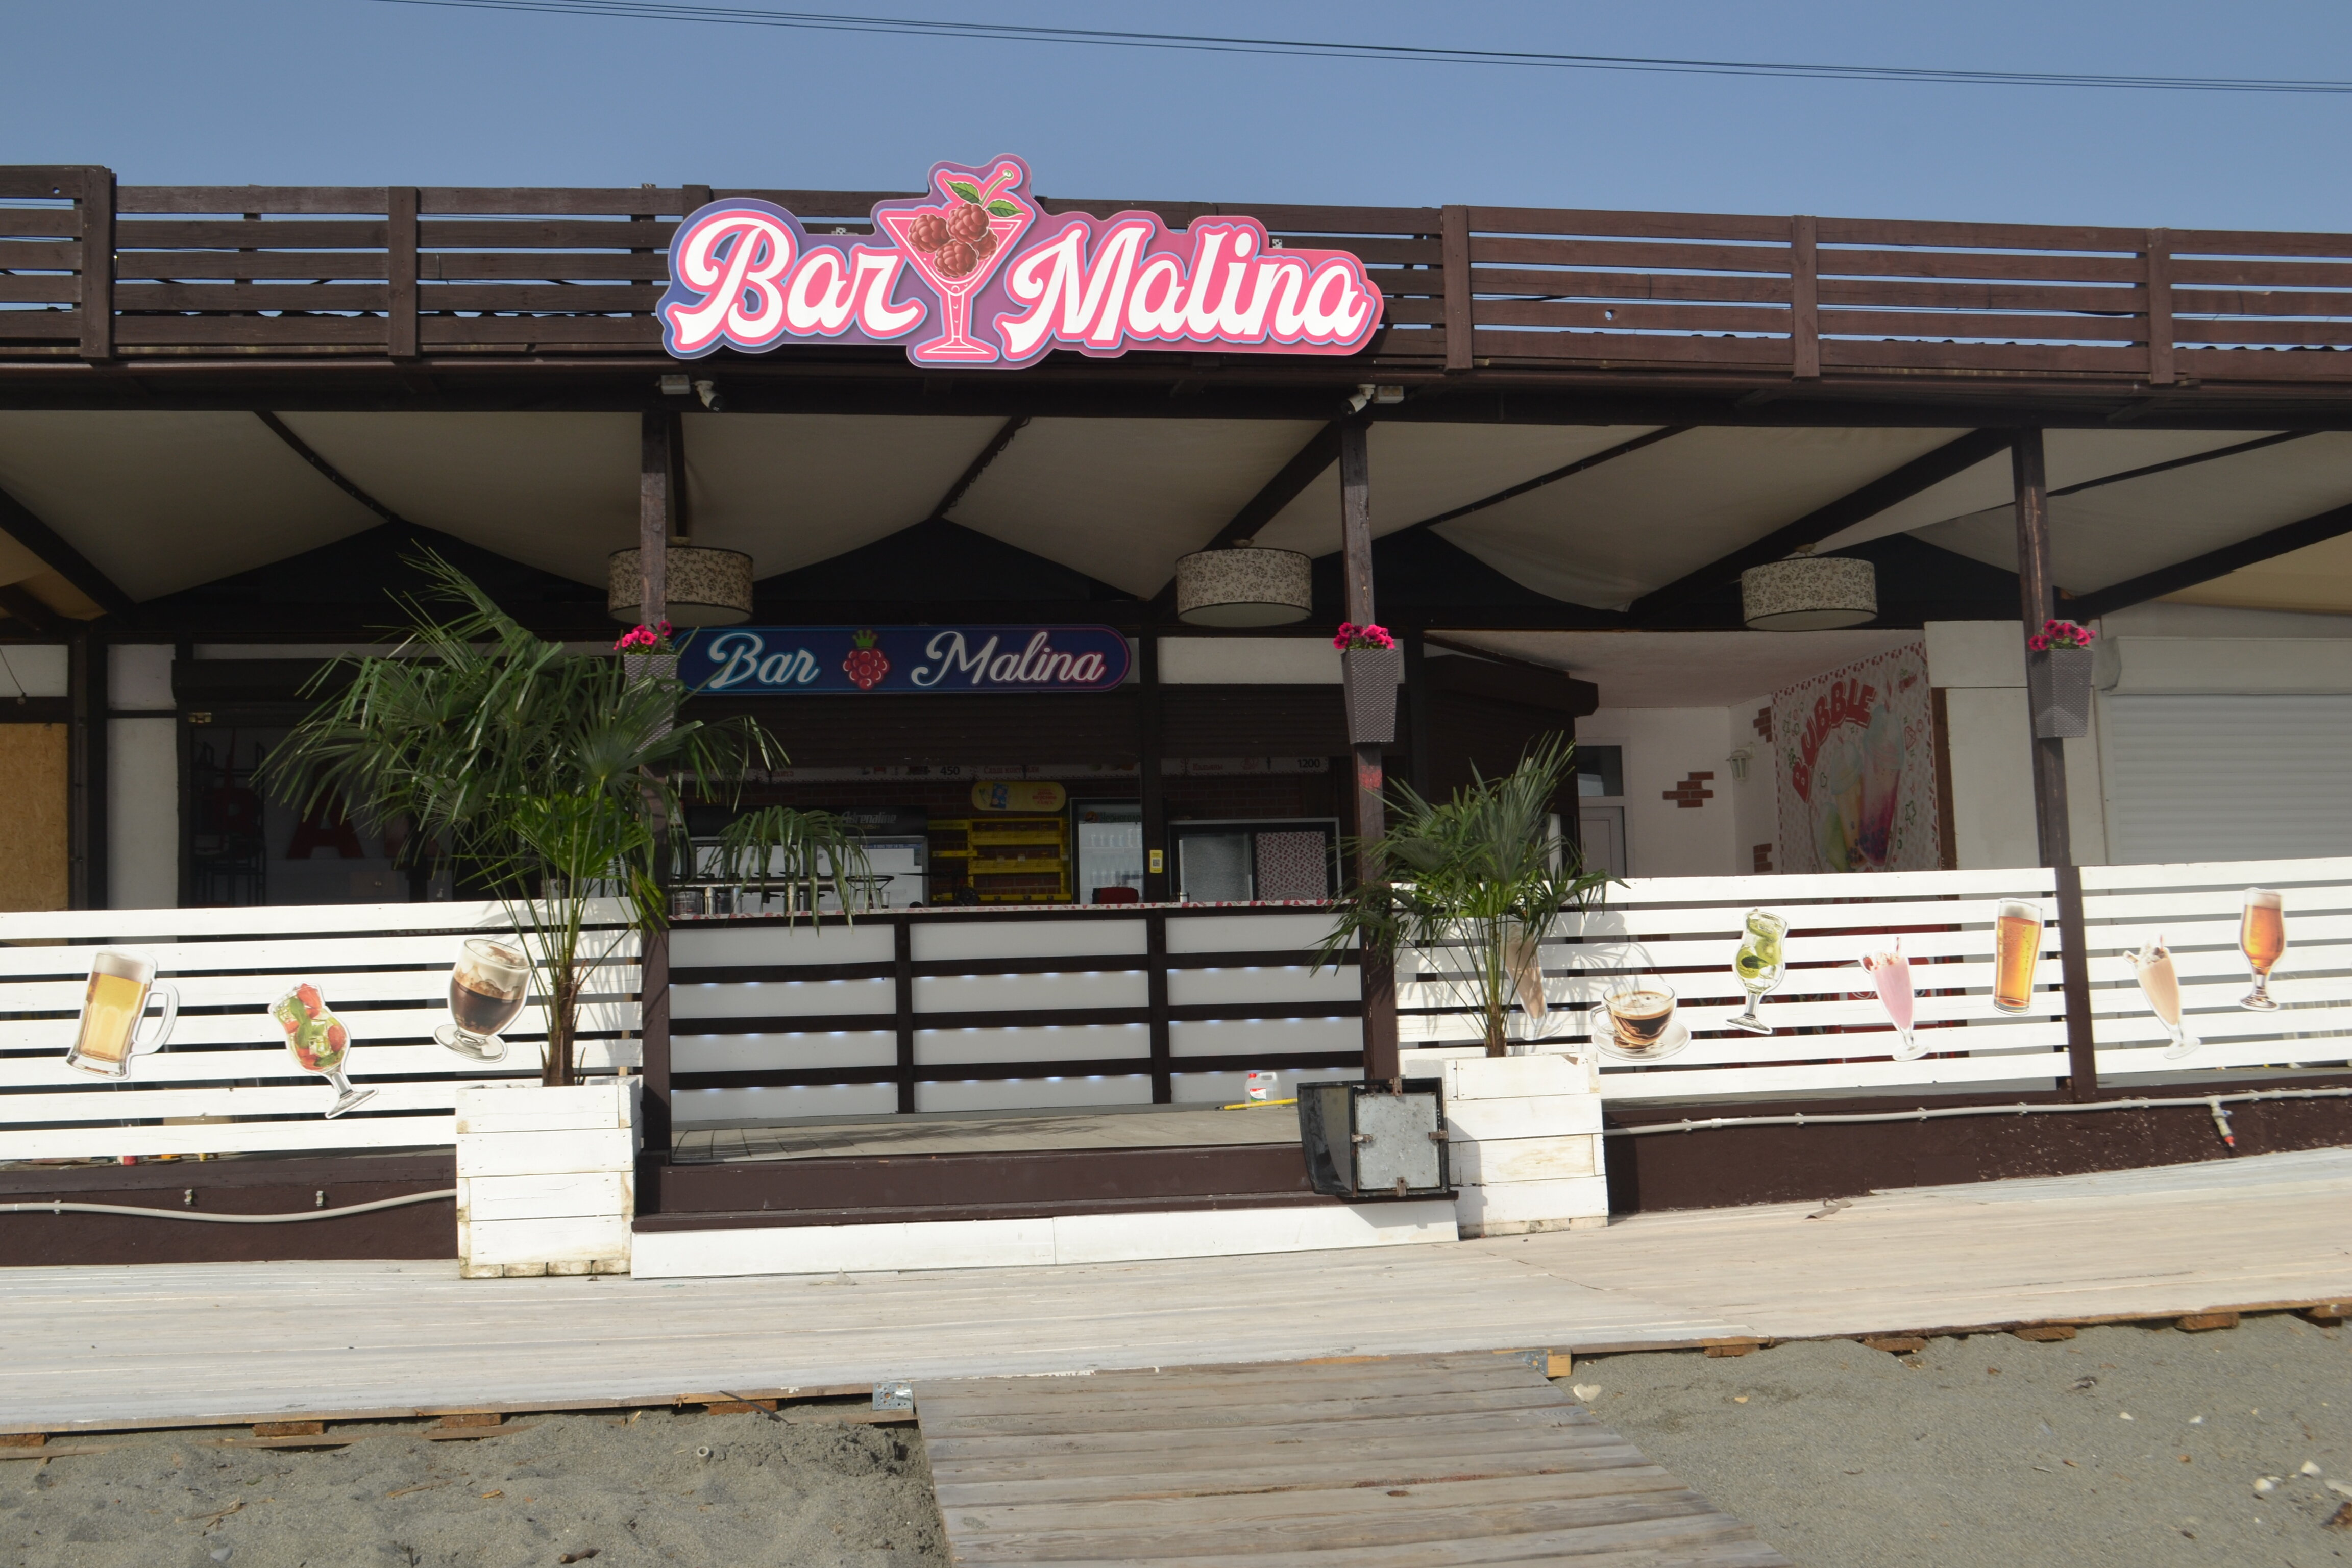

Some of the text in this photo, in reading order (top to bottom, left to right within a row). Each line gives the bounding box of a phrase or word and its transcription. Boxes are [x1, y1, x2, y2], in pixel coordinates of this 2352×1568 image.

[672, 215, 1375, 353] Bar Malina
[708, 630, 1105, 689] Bar Malina
[1792, 677, 1877, 803] BUBBLE
[1297, 758, 1321, 768] 1200
[940, 766, 960, 775] 450
[842, 810, 897, 824] Adrenaline
[1100, 812, 1142, 825] Черноголо
